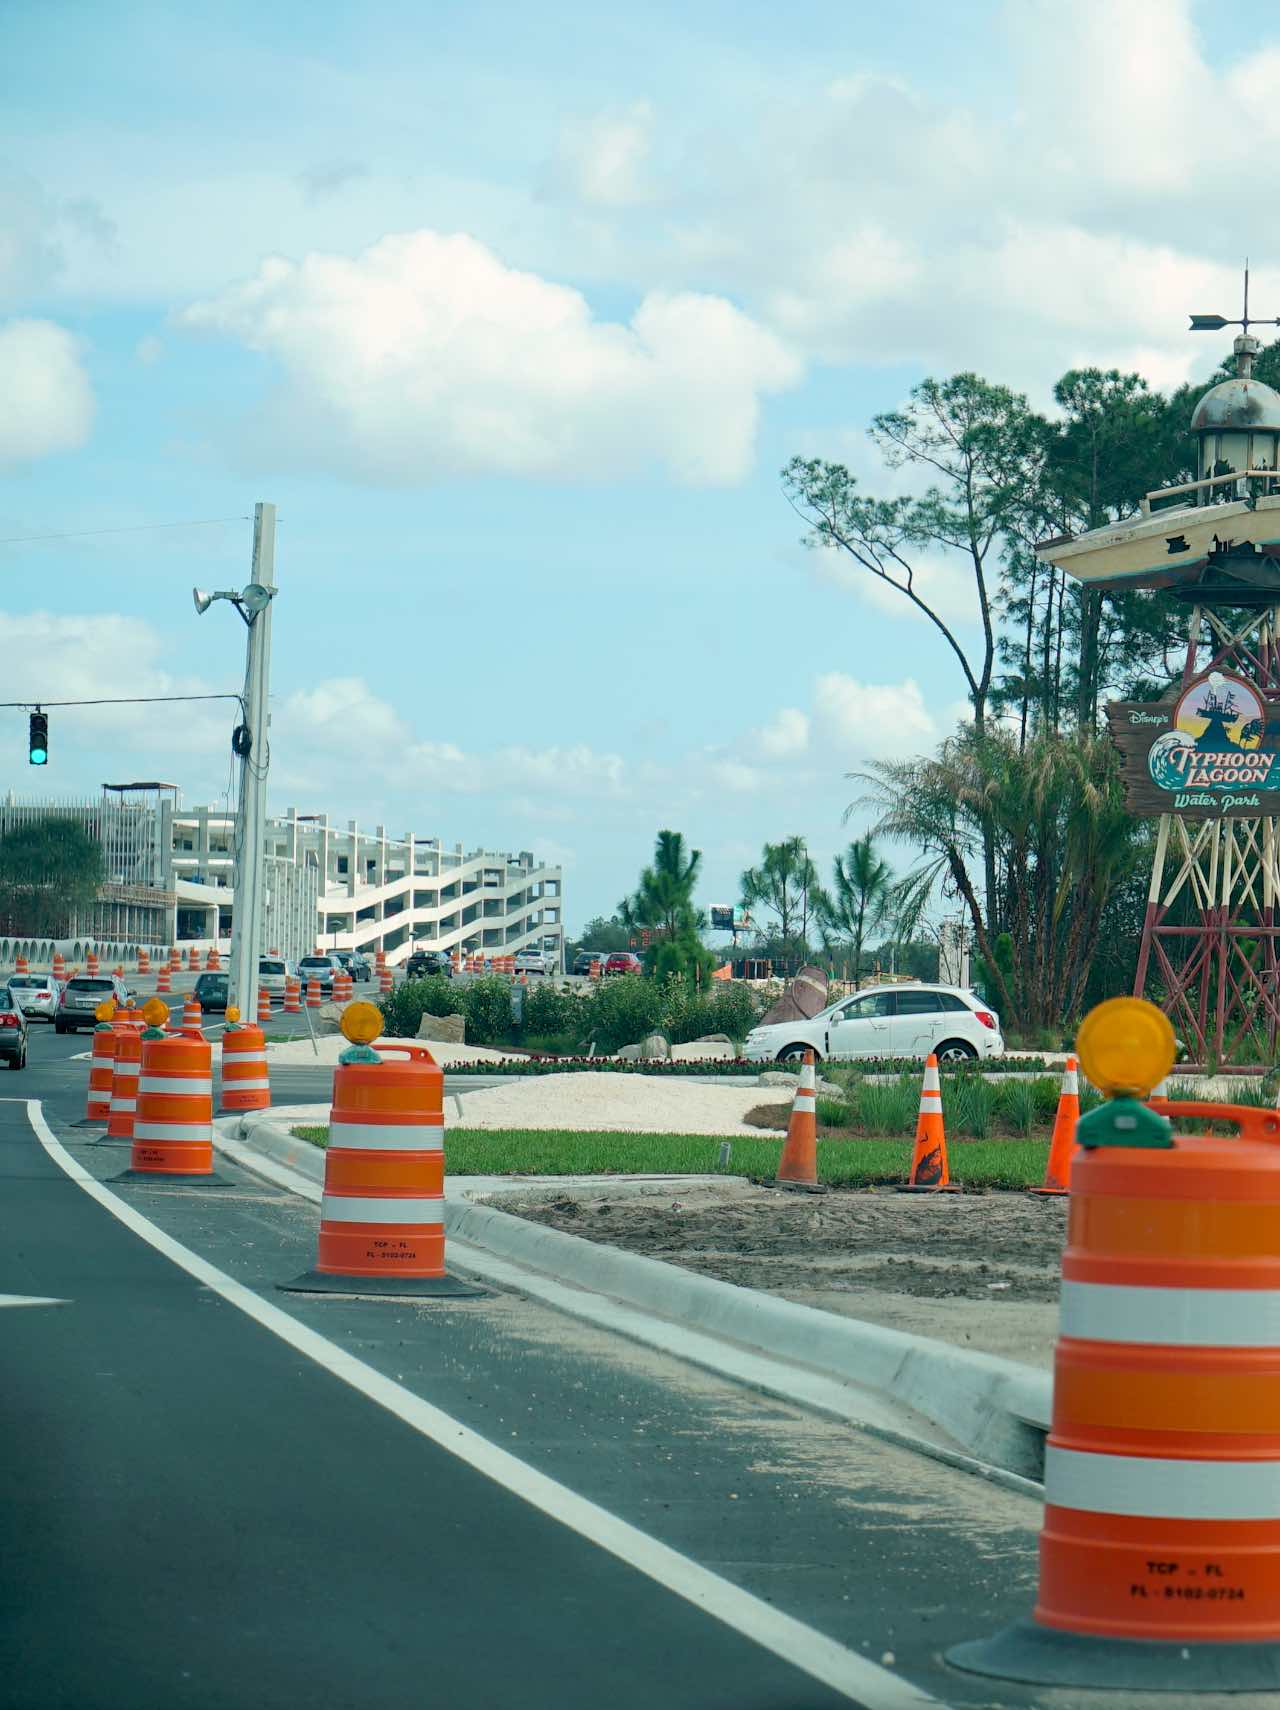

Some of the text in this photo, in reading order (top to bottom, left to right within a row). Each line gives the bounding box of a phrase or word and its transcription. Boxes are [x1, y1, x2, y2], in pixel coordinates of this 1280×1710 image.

[1128, 710, 1169, 727] Disney's
[1170, 747, 1276, 774] TYPHOON
[1184, 768, 1269, 787] LAGOON
[1174, 794, 1260, 813] Water Park
[1147, 1562, 1178, 1574] TCP
[1205, 1564, 1223, 1577] FL
